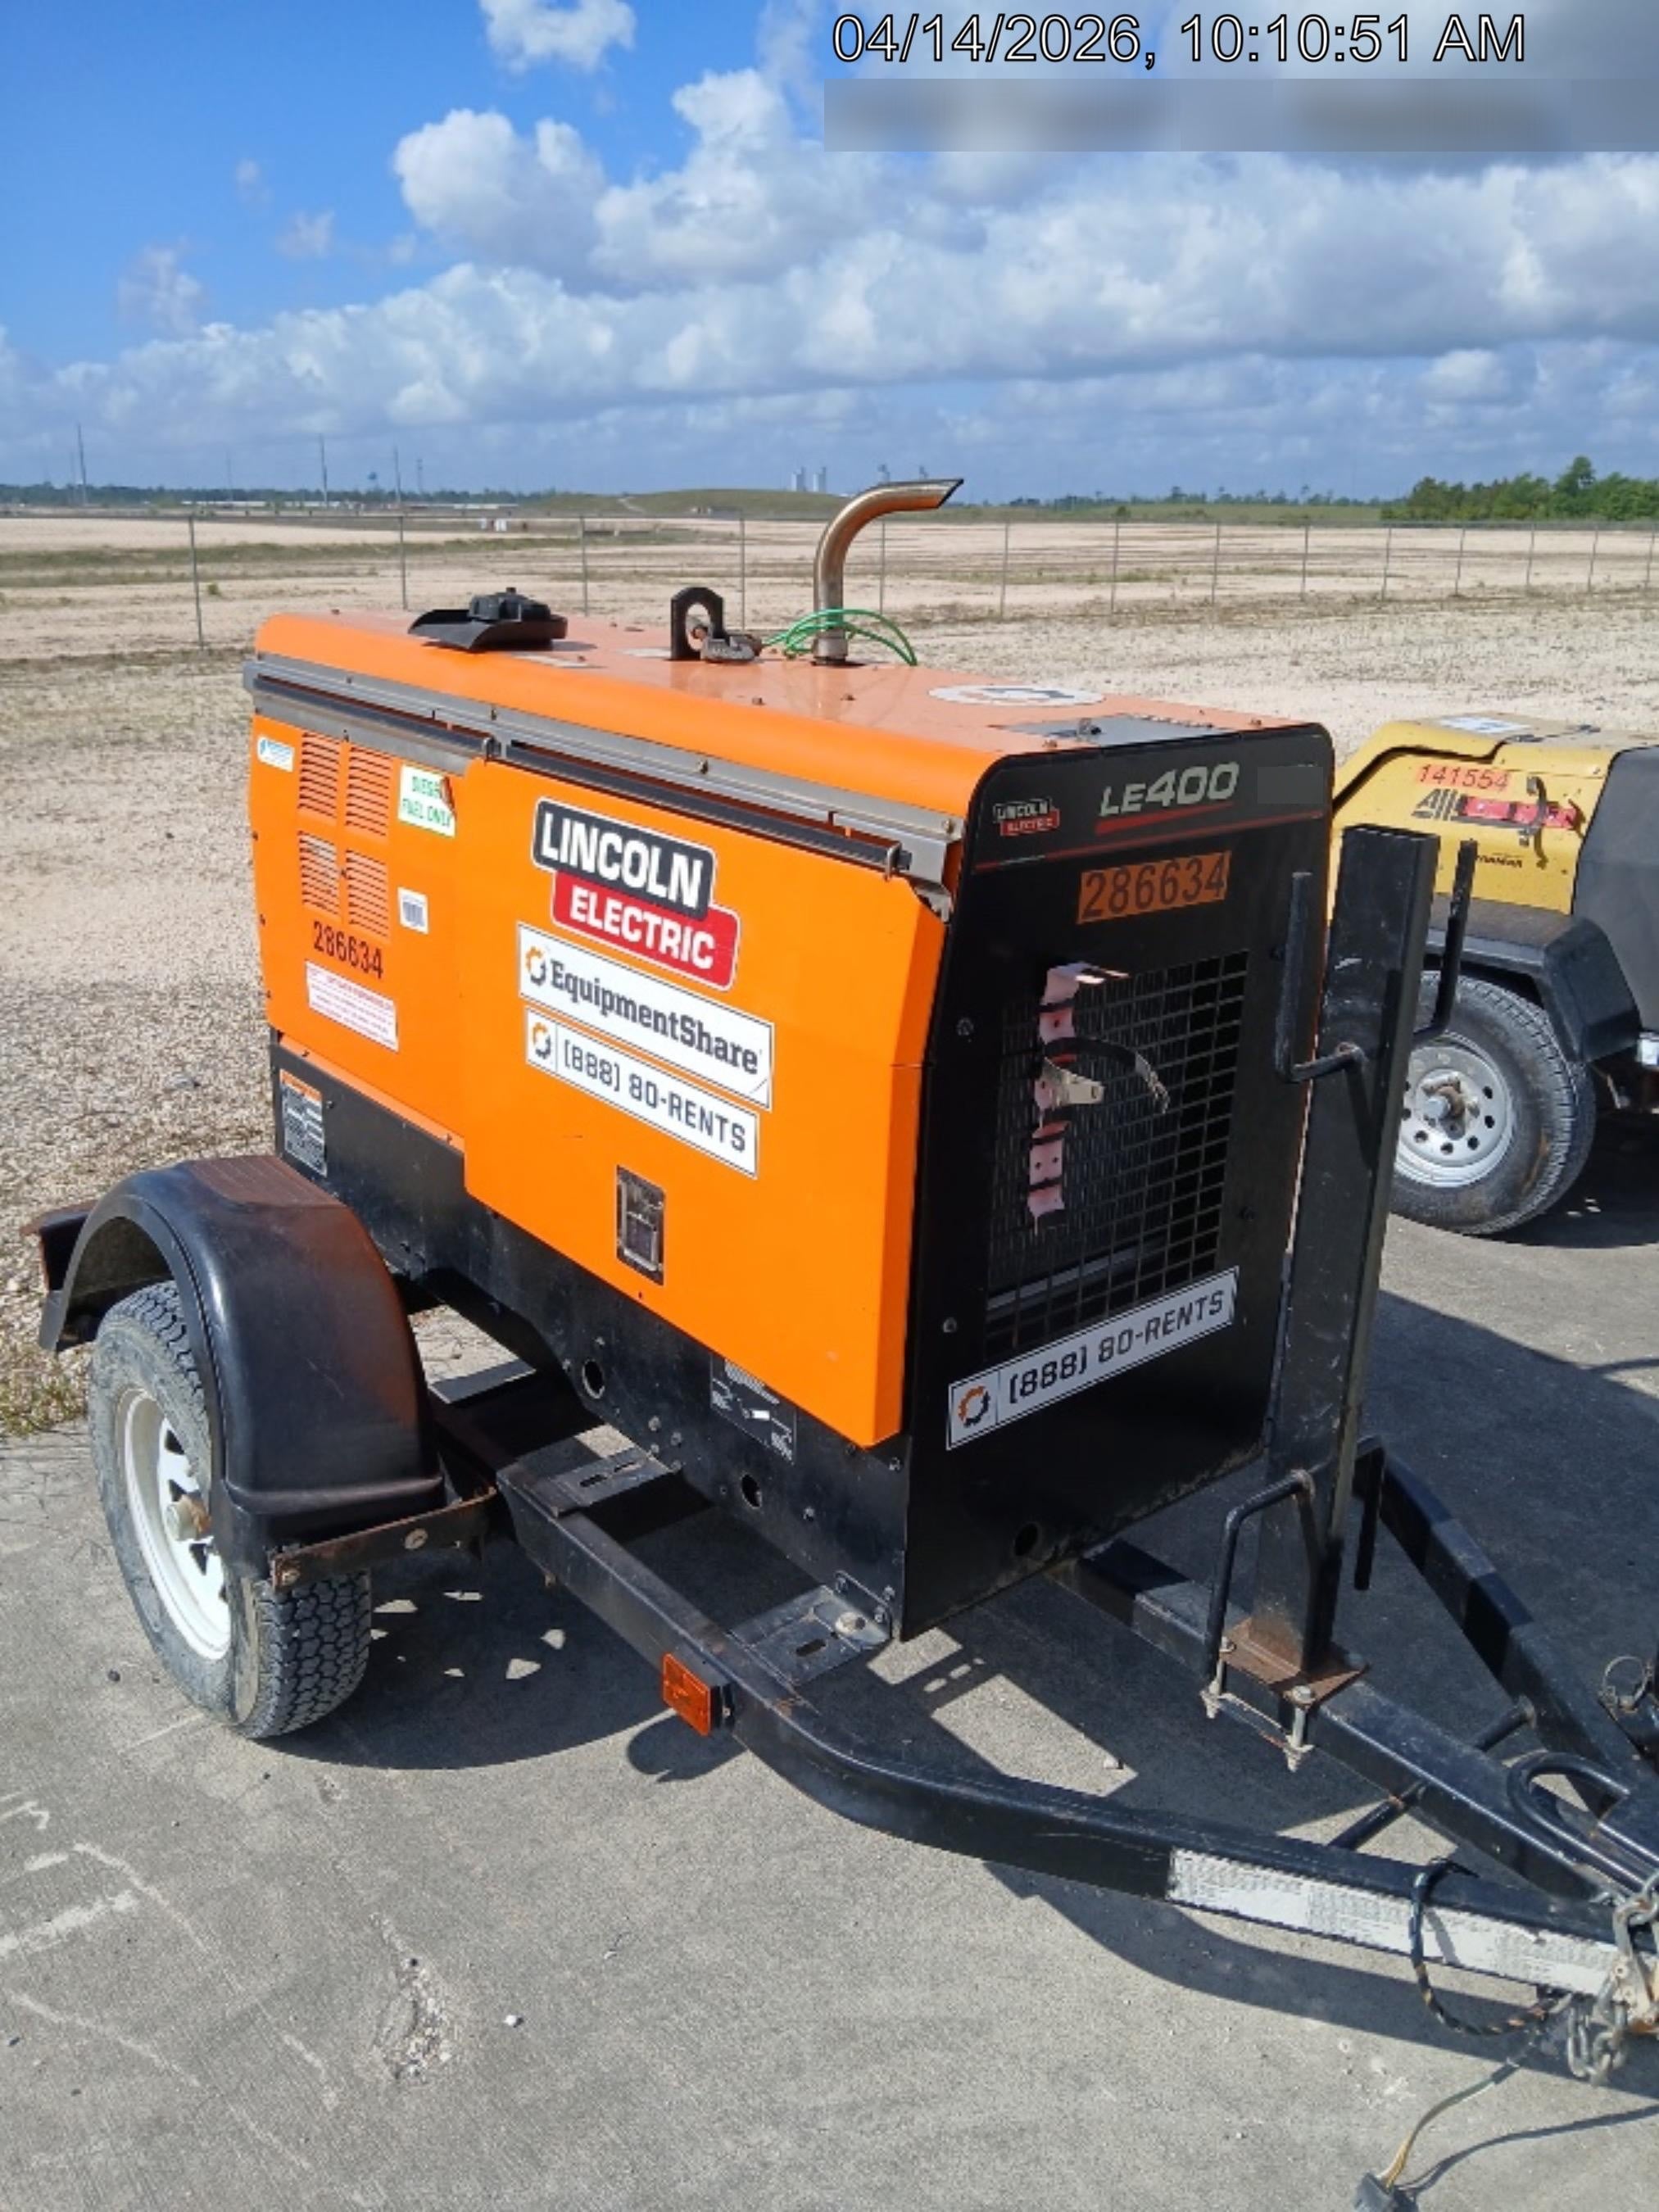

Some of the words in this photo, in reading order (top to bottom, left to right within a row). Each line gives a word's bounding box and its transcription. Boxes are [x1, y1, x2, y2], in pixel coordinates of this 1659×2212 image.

[1099, 761, 1240, 817] LE400
[1420, 764, 1508, 791] 141554
[541, 812, 703, 909] LINCOLN
[1081, 858, 1225, 919] 286634
[313, 920, 383, 979] 286634
[569, 886, 715, 970] ELECTRIC
[550, 959, 758, 1075] EquipmentShare
[564, 1039, 620, 1091] (888)
[628, 1072, 746, 1152] 80-RENTS
[1009, 1346, 1087, 1404] (888)
[1097, 1290, 1224, 1363] 80-RENTS
